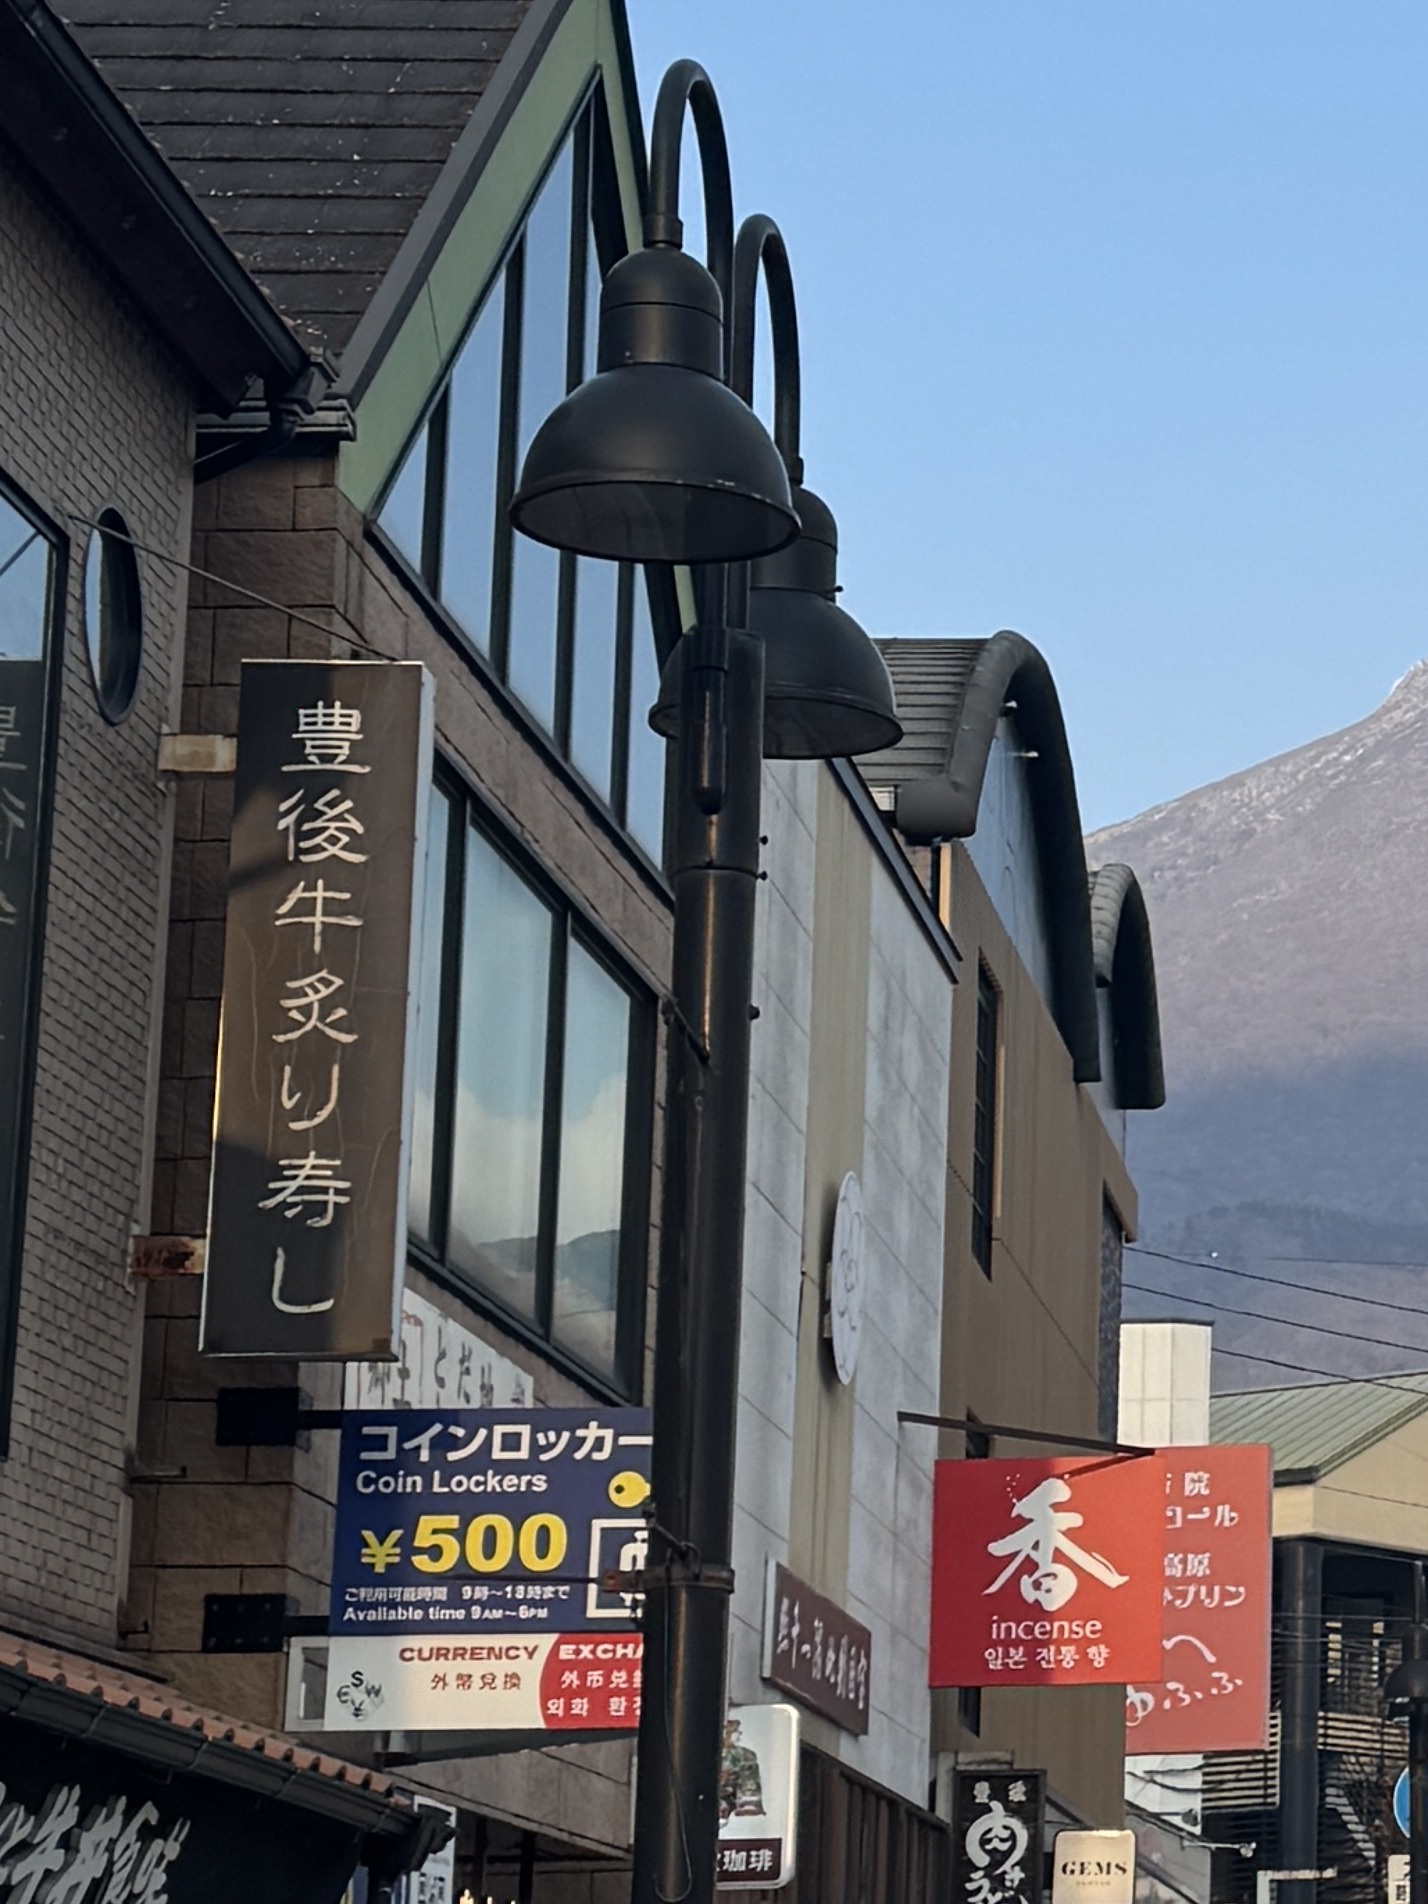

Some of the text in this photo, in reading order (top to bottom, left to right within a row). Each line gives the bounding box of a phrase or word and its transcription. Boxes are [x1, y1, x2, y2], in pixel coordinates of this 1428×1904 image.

[258, 699, 371, 1315] 豊後牛炙り寿し
[357, 1421, 653, 1463] コインロッカー
[356, 1469, 548, 1494] Coin Lockers
[360, 1512, 568, 1574] ¥500
[983, 1477, 1130, 1613] 香
[343, 1606, 424, 1621] Available
[428, 1605, 466, 1620] time
[991, 1615, 1103, 1640] incense
[398, 1644, 540, 1663] CURRENCY
[984, 1645, 1028, 1670] 일본
[1085, 1643, 1111, 1669] 향
[546, 1697, 589, 1718] 외화
[1061, 1860, 1128, 1876] GEMS
